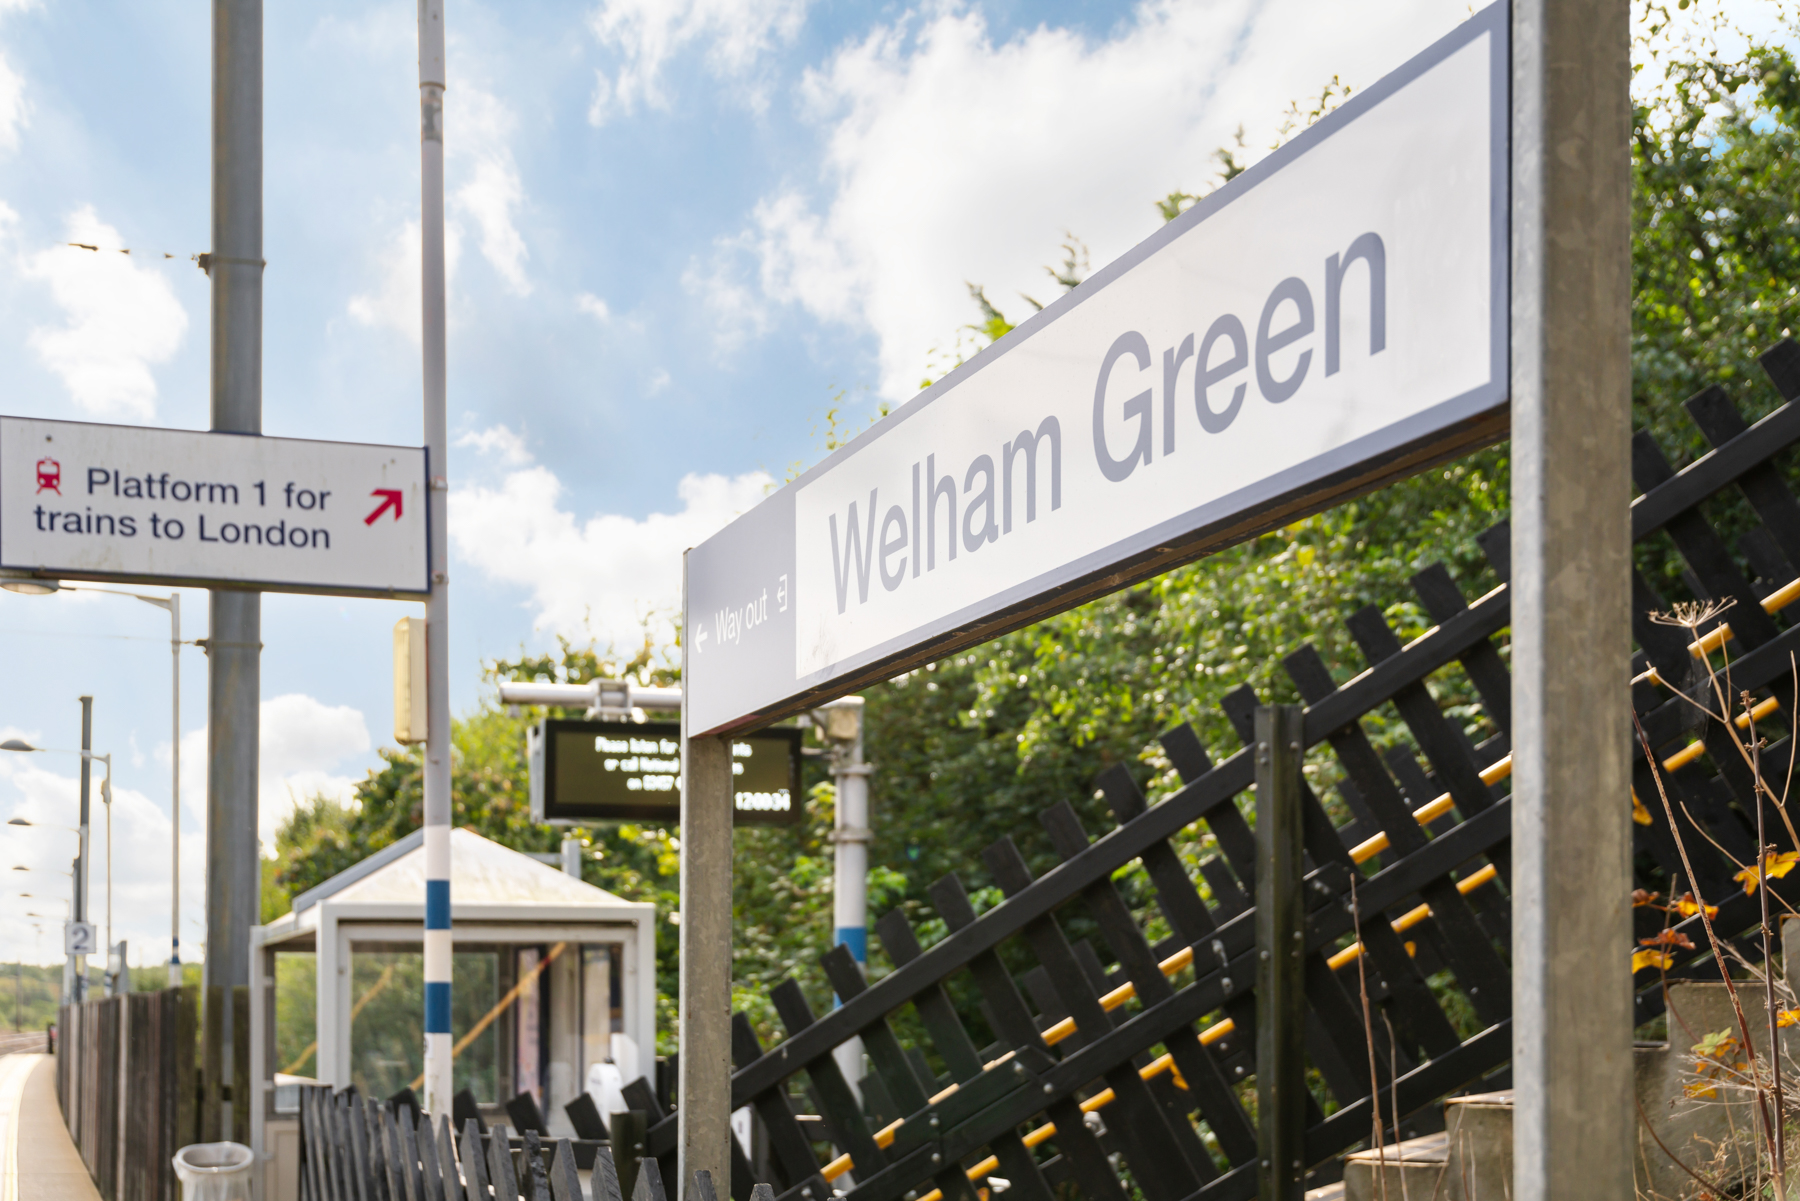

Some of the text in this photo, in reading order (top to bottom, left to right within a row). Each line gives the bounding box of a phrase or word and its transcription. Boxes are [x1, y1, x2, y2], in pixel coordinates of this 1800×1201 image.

[828, 231, 1387, 616] Welham Green
[86, 467, 332, 511] Platform 1 for
[33, 504, 331, 550] trains to London
[715, 587, 768, 645] Way out
[72, 927, 89, 950] 2
